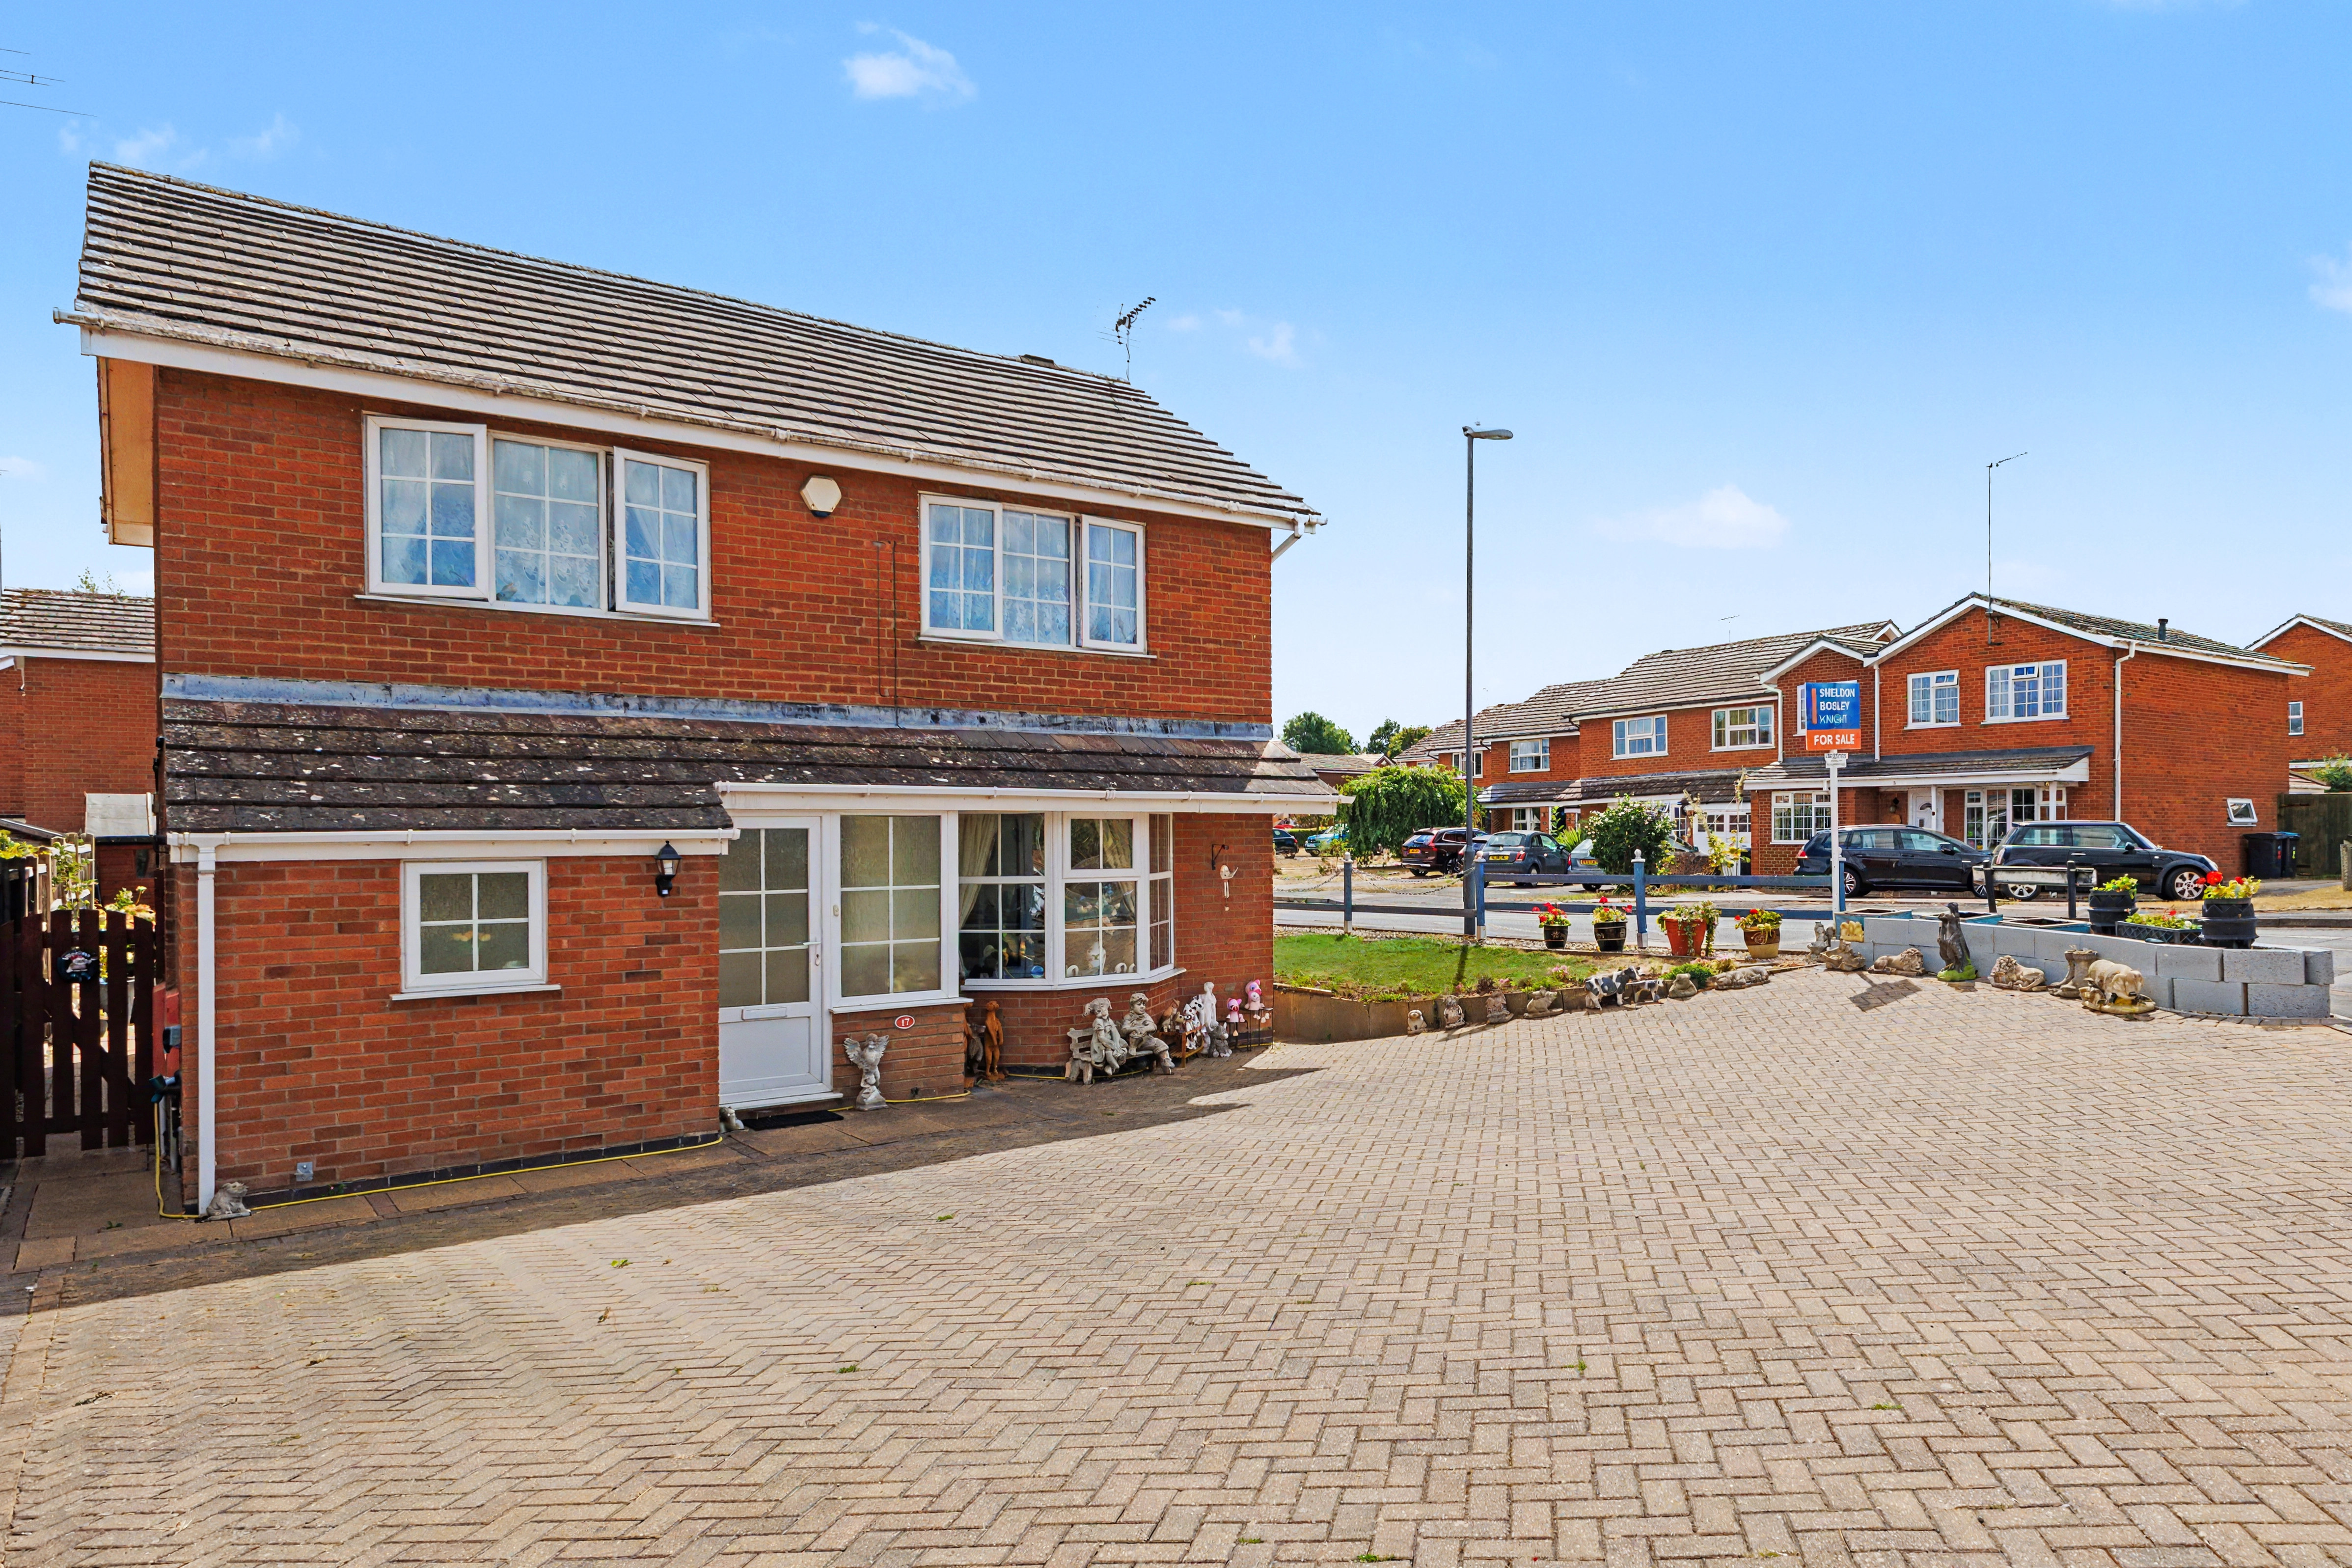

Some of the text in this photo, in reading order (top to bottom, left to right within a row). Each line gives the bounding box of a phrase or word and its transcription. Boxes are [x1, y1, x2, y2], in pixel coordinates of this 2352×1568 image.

[1820, 688, 1855, 697] SHELDON
[1820, 701, 1850, 711] BOSLEY
[1814, 734, 1855, 745] FOR SALE
[902, 1018, 910, 1026] 17
